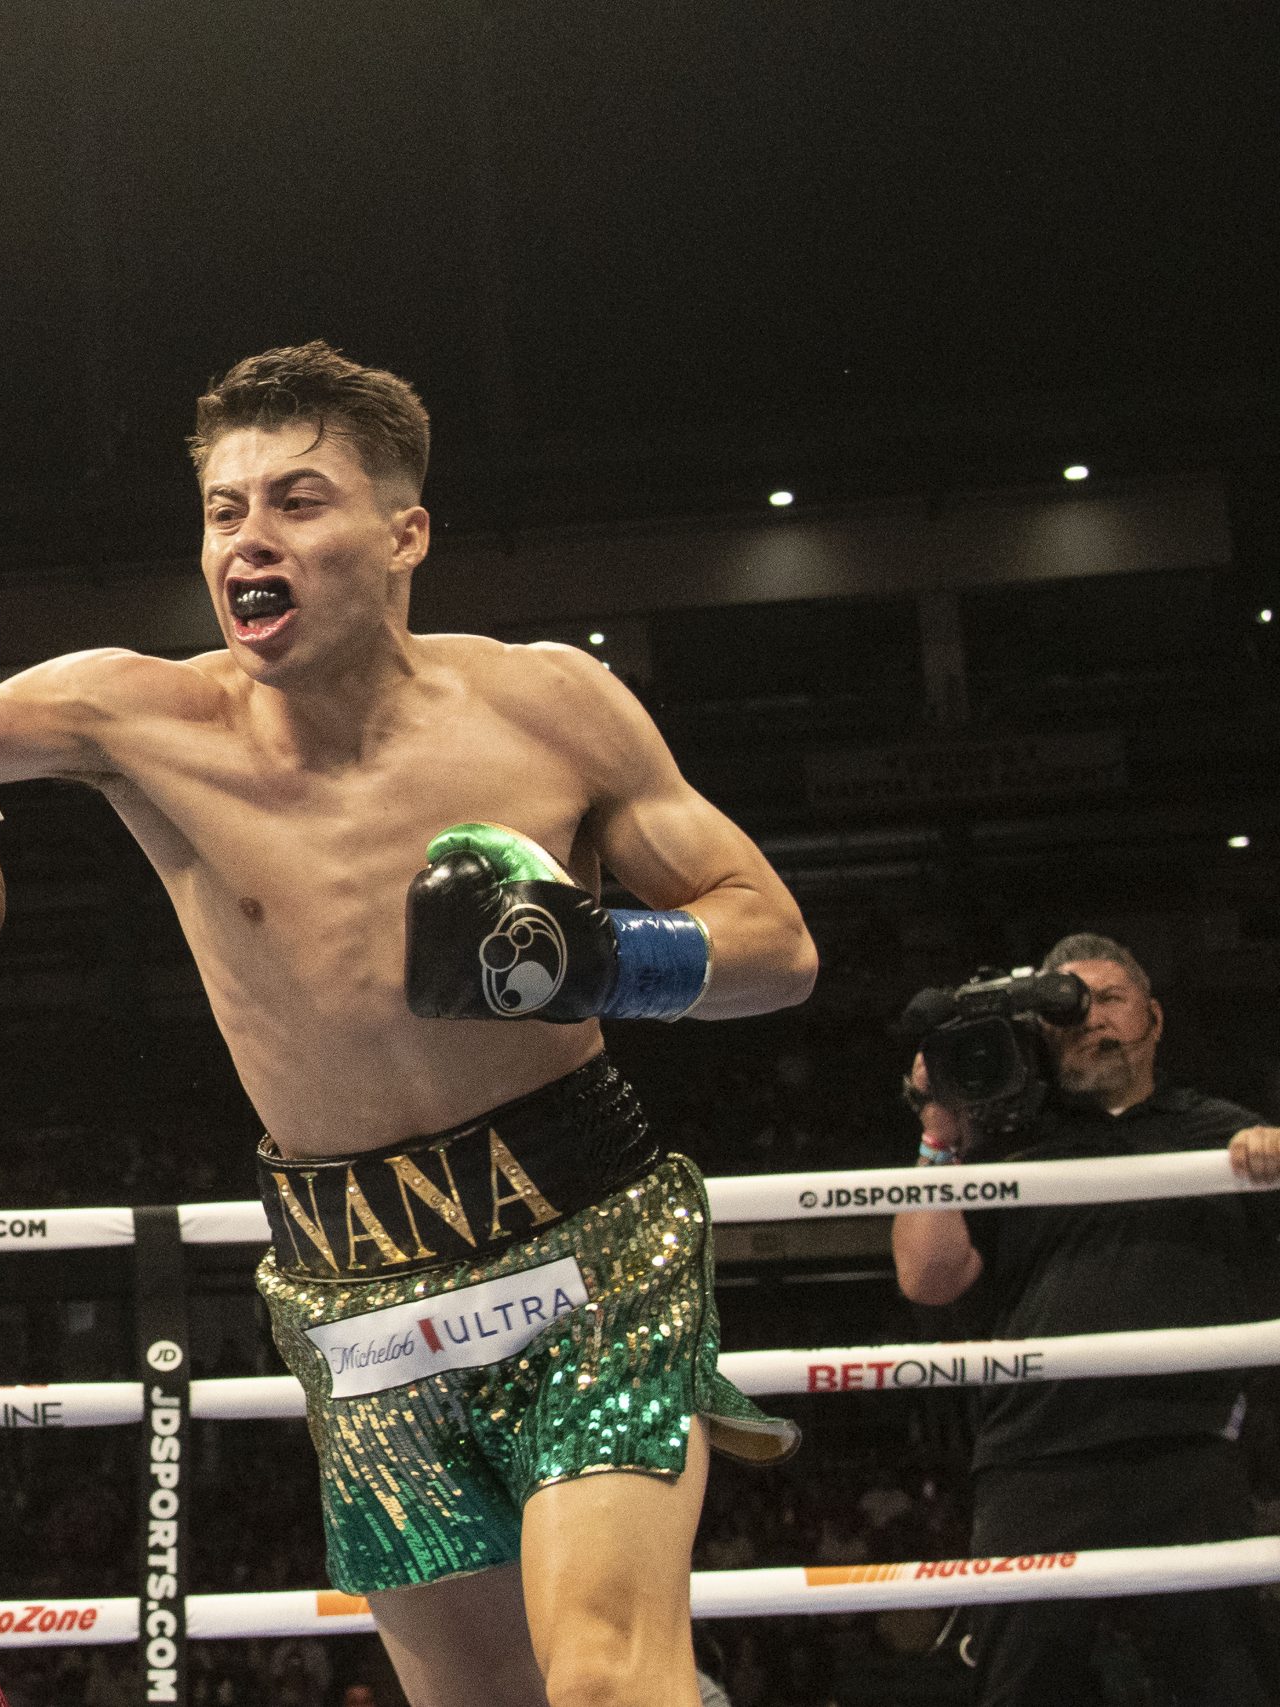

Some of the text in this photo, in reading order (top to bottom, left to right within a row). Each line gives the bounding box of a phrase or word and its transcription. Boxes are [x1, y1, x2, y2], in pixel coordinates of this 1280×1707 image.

[271, 1127, 562, 1273] NANA
[822, 1181, 1019, 1208] JDSPORTS.COM
[331, 1287, 576, 1374] Michelob ULTRA
[146, 1385, 181, 1702] JDSPORTS.COM
